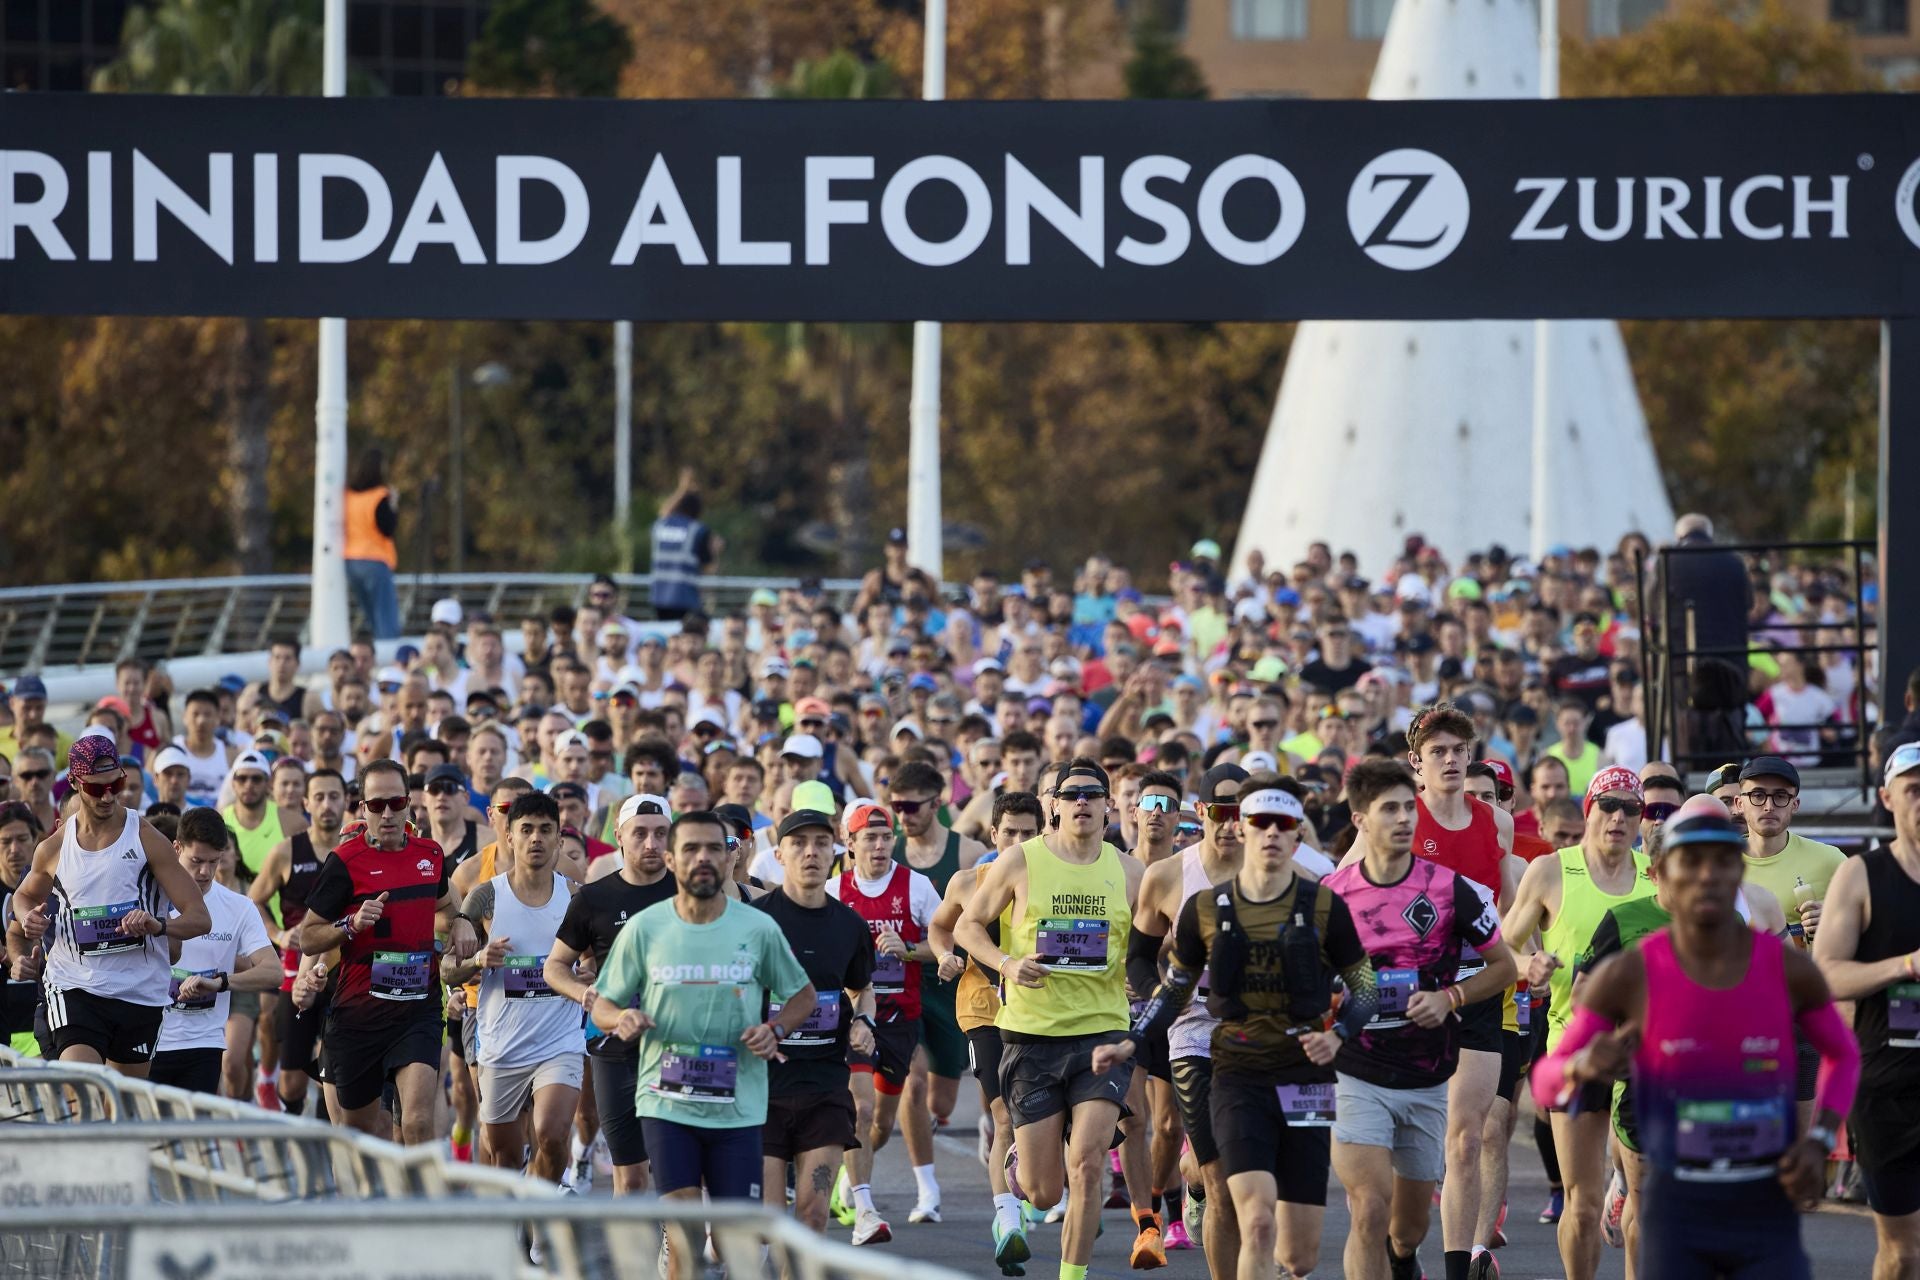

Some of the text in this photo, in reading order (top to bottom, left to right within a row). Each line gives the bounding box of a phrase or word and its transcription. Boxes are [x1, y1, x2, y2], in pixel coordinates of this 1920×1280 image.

[611, 153, 1305, 267] ALFONSO
[1512, 175, 1849, 241] ZURICH
[1052, 894, 1107, 906] MIDNIGHT
[1052, 904, 1107, 916] RUNNERS
[1056, 933, 1089, 945] 36477
[1063, 946, 1081, 955] Adri
[391, 966, 417, 976] 14302
[651, 964, 753, 981] COSTA RICA
[681, 1060, 715, 1073] 11651
[46, 1182, 134, 1206] RUNNING
